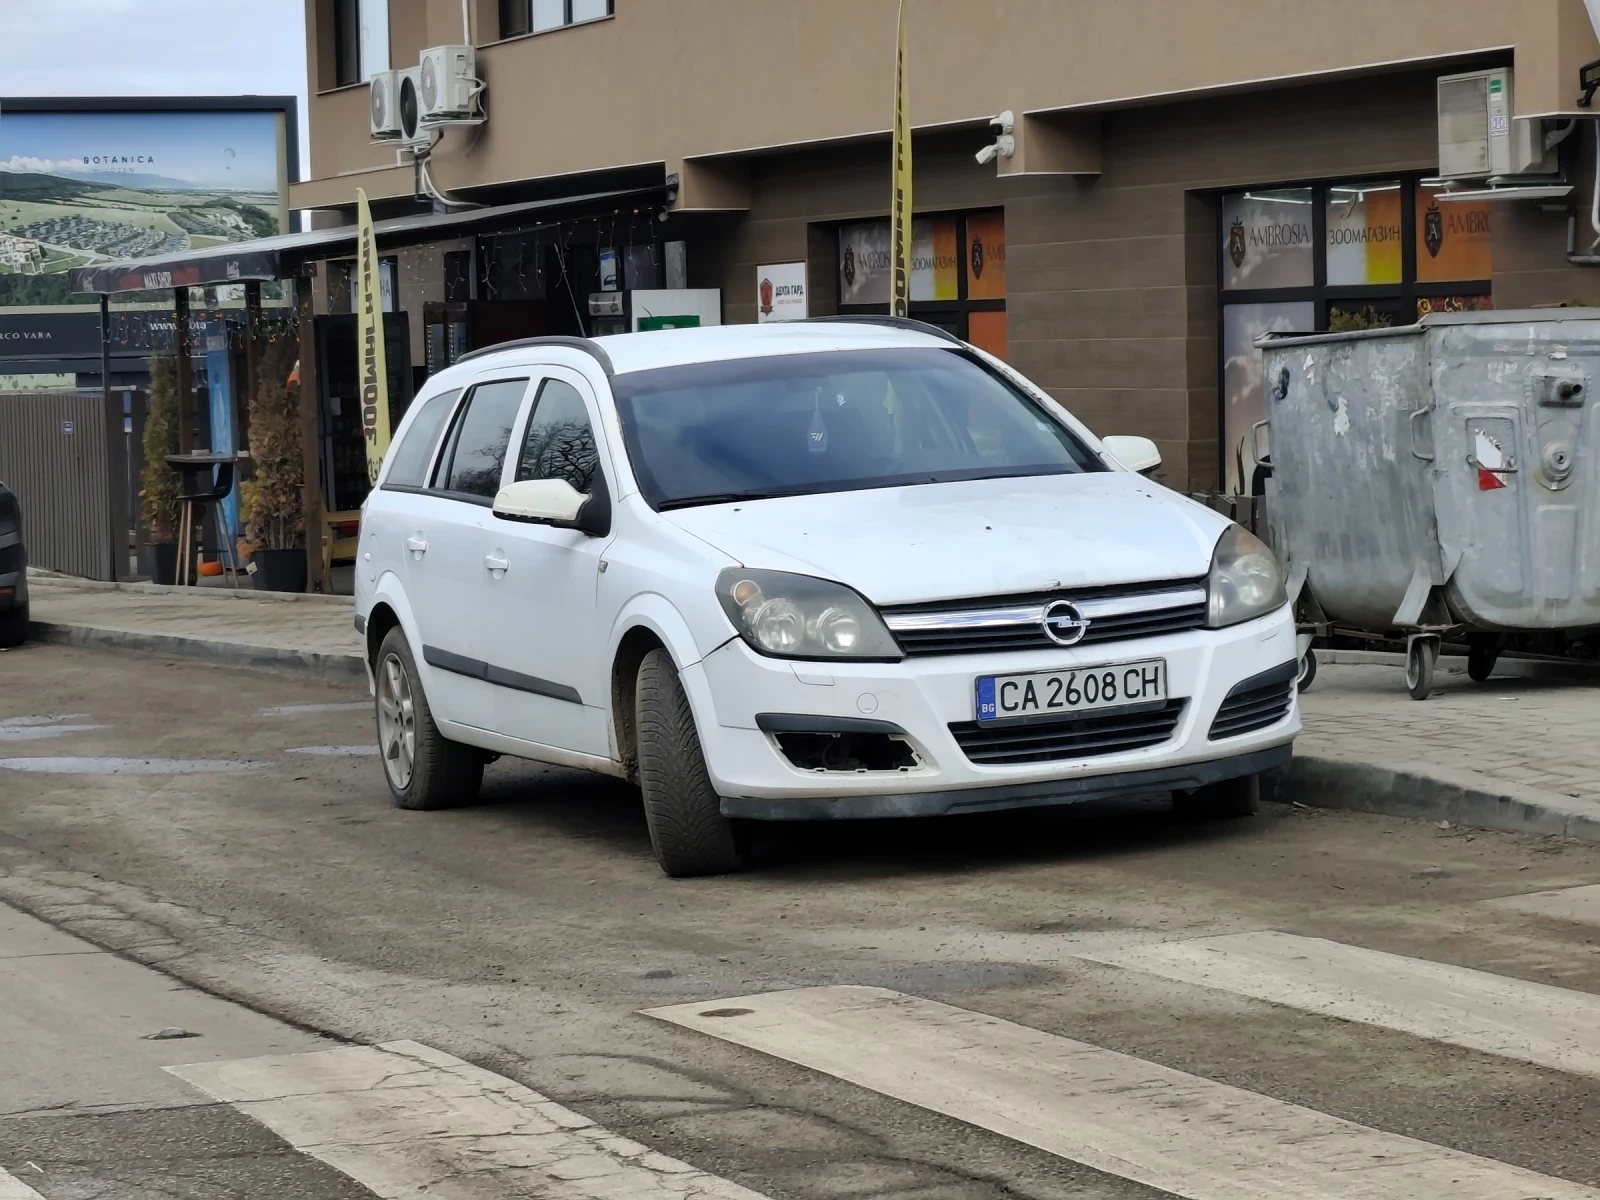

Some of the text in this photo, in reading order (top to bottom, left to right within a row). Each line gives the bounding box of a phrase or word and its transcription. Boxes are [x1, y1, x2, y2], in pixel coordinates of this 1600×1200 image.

[83, 155, 155, 165] BOTANICA
[1248, 223, 1310, 246] AMBROSIA
[1328, 226, 1400, 246] ЗООМАГАЗИН
[911, 255, 957, 271] ЗООМАГАЗИН
[23, 331, 52, 339] VARA
[1000, 665, 1159, 712] CA 2608 CH
[981, 703, 995, 714] BG
